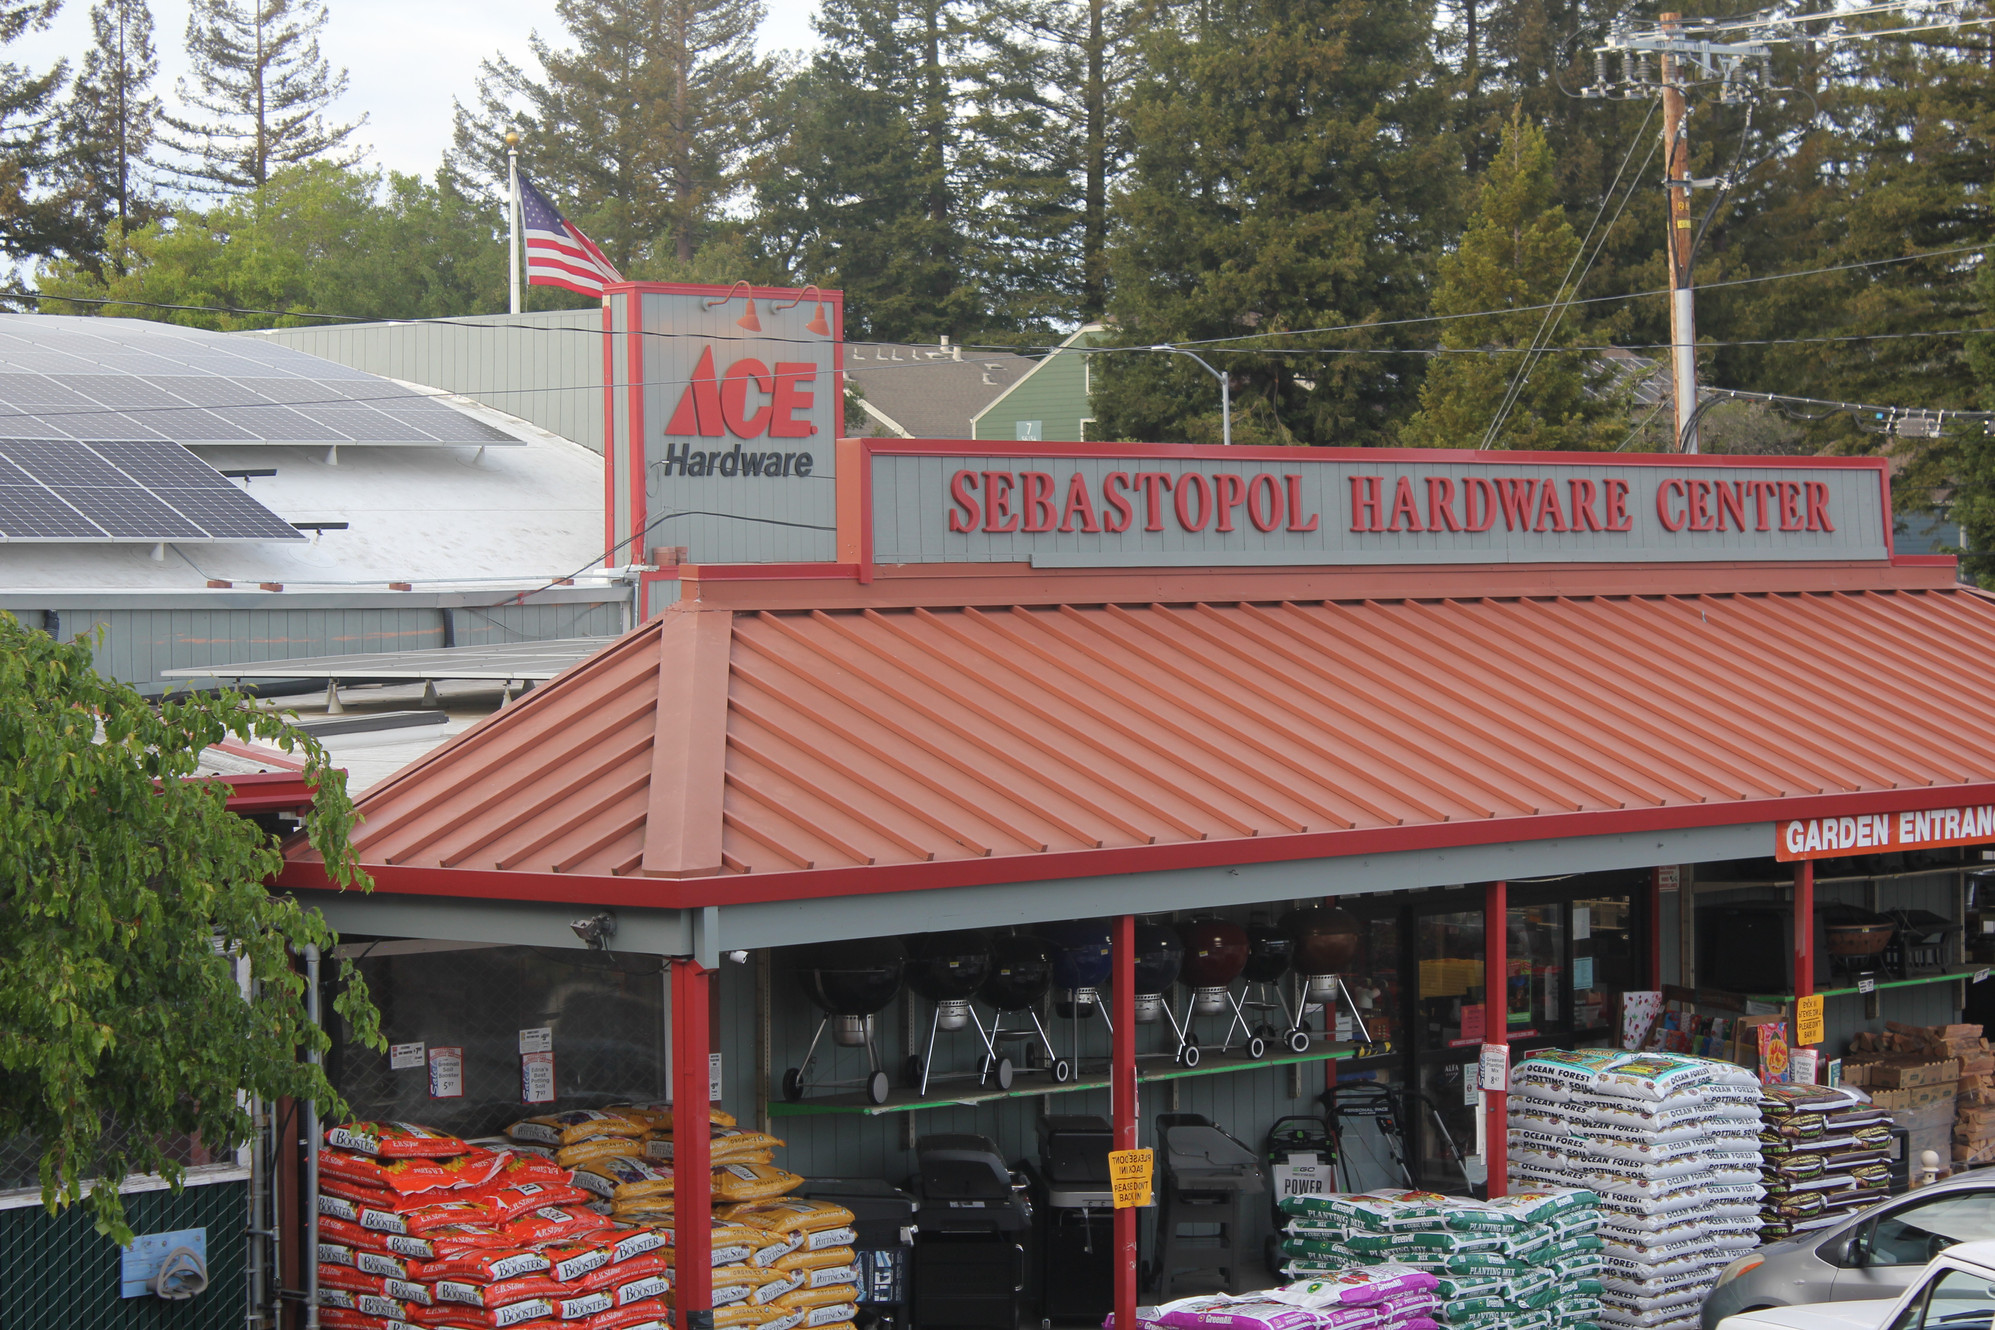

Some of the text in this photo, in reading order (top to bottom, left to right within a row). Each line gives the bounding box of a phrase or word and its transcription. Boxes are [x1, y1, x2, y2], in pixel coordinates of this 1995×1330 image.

[664, 344, 818, 440] ACE
[664, 443, 814, 477] Hardware
[949, 469, 1836, 533] SEBASTOPOL HARDWARE CENTER
[1786, 805, 1995, 854] GARDEN ENTRAN
[1527, 1064, 1590, 1082] OCEAN FOREST
[1671, 1068, 1710, 1085] OCEAN FOREST
[1526, 1075, 1565, 1087] POTTING
[1526, 1097, 1589, 1113] OCEAN FORES
[1584, 1100, 1623, 1110] POTTING
[1671, 1104, 1718, 1117] OCEAN FOREST
[1525, 1108, 1565, 1120] POTTING
[1613, 1124, 1644, 1133] FOREST
[336, 1130, 375, 1151] BOOSTER
[1524, 1131, 1552, 1141] OCEAN
[1583, 1133, 1622, 1141] POTTING
[1523, 1142, 1586, 1157] POTTING SOIL
[1669, 1141, 1691, 1150] OCEAN
[1522, 1163, 1551, 1173] OCEAN
[1581, 1156, 1644, 1167] OCEAN FOREST
[1583, 1167, 1621, 1176] POTTING
[1284, 1178, 1322, 1194] POWER
[1521, 1174, 1561, 1186] POTTING
[1667, 1176, 1689, 1186] OCEAN
[1613, 1195, 1641, 1203] FOREST
[1307, 1210, 1366, 1229] PLANTING MIX
[1666, 1209, 1688, 1219] OCEAN
[366, 1213, 402, 1231] BOOSTER
[1469, 1223, 1515, 1232] PLANTING MIX
[619, 1237, 659, 1259] BOOSTER
[1666, 1242, 1688, 1251] OCEAN
[364, 1254, 400, 1276] BOOSTER
[499, 1260, 543, 1277] BOOSTER
[563, 1255, 606, 1278] BOOSTER
[1608, 1258, 1638, 1268] FOREST
[1470, 1267, 1515, 1276] PLANTING MIX
[1621, 1270, 1640, 1278] SOIL
[1664, 1274, 1687, 1283] OCEAN
[391, 1281, 428, 1302] BOOSTER
[442, 1284, 478, 1302] BOOSTER
[626, 1282, 665, 1300] BOOSTER
[364, 1298, 400, 1317] BOOSTER
[503, 1305, 545, 1323] BOOSTER
[568, 1299, 608, 1317] BOOSTER
[1661, 1304, 1684, 1314] OCEAN
